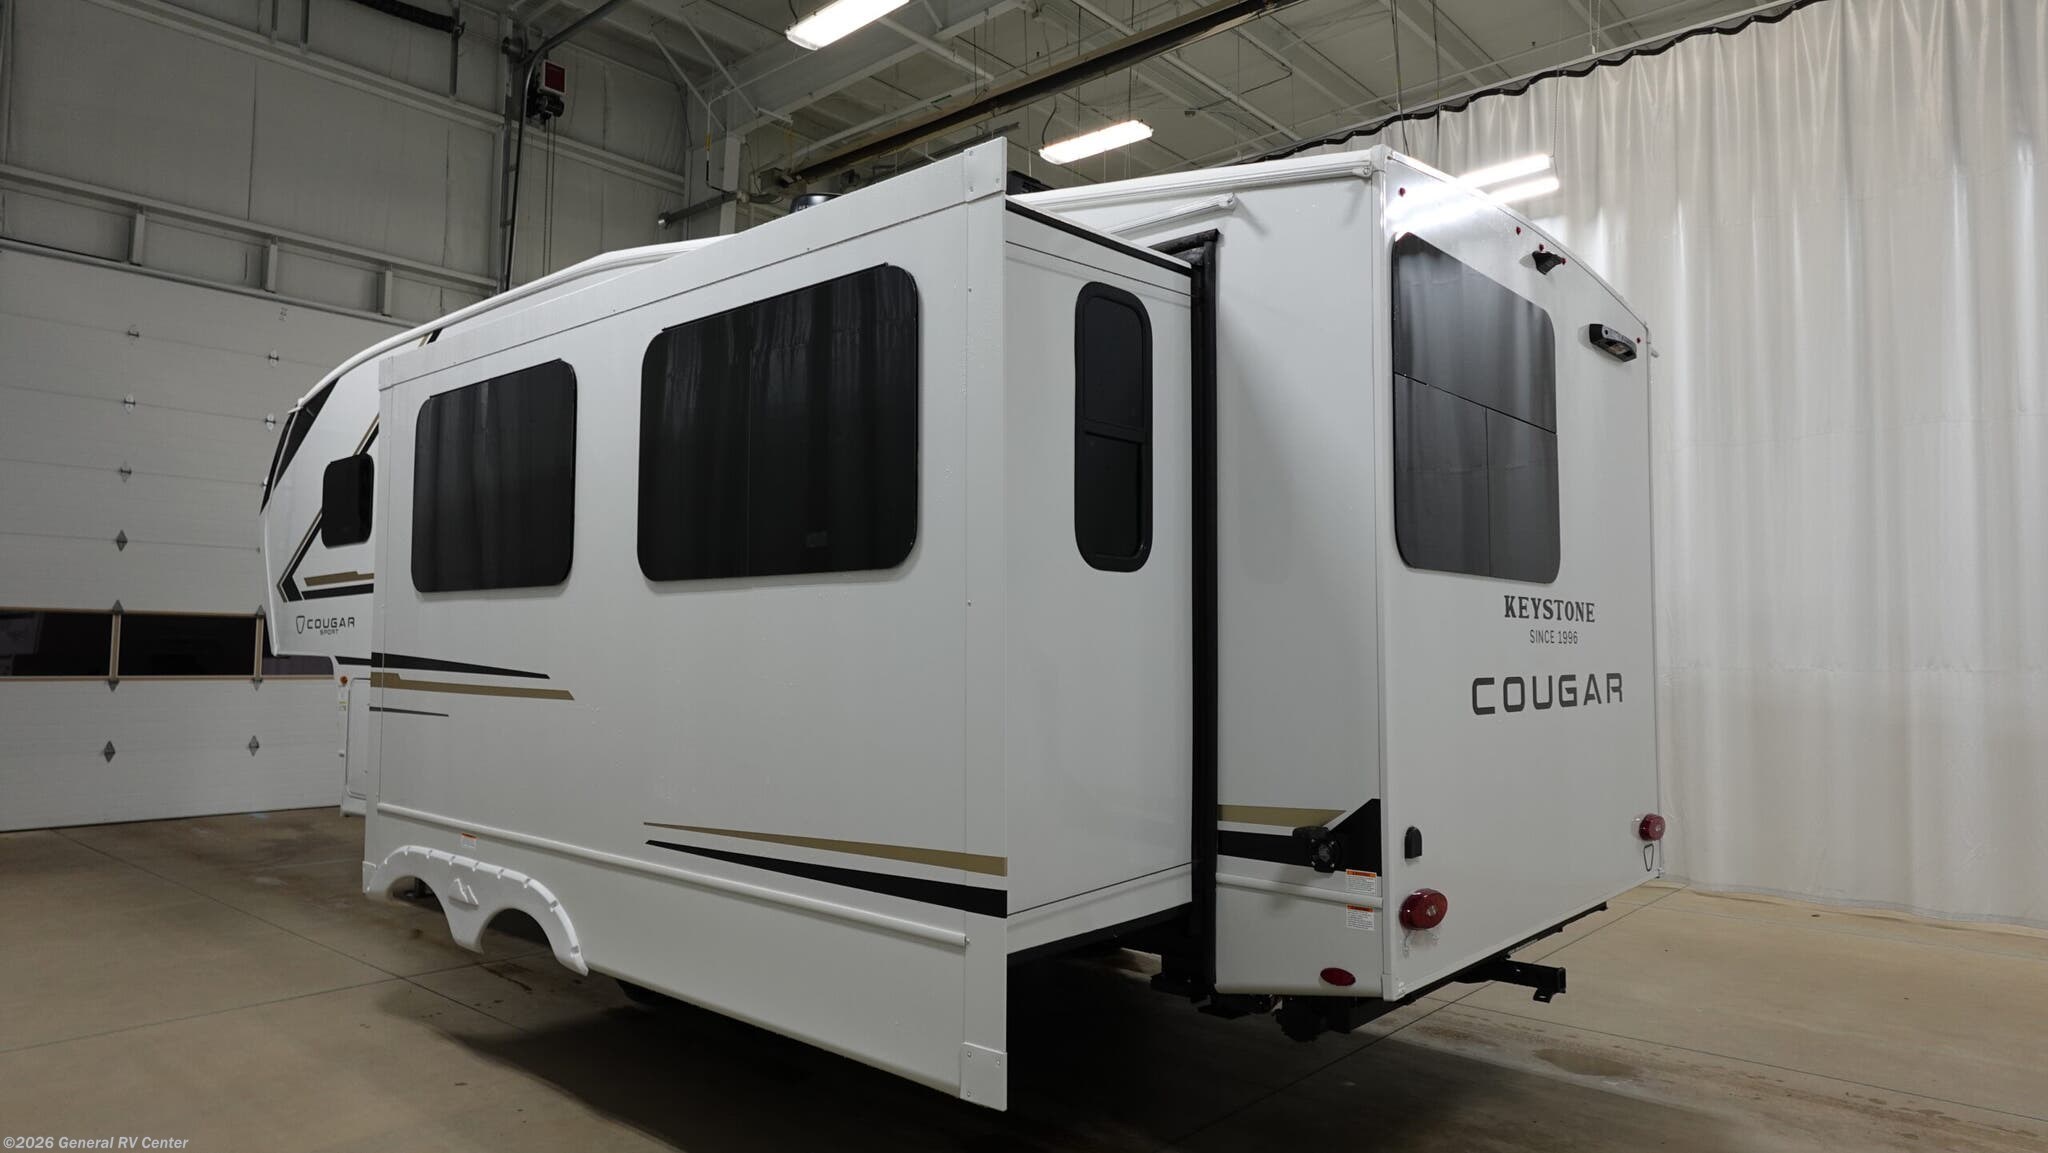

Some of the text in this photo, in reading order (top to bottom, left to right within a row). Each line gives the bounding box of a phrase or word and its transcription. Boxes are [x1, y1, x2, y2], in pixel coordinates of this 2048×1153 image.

[1504, 595, 1596, 623] KEYSTONE
[307, 617, 355, 629] COUGAR
[1530, 629, 1578, 645] SINCE 1996
[1472, 673, 1623, 715] COUGAR
